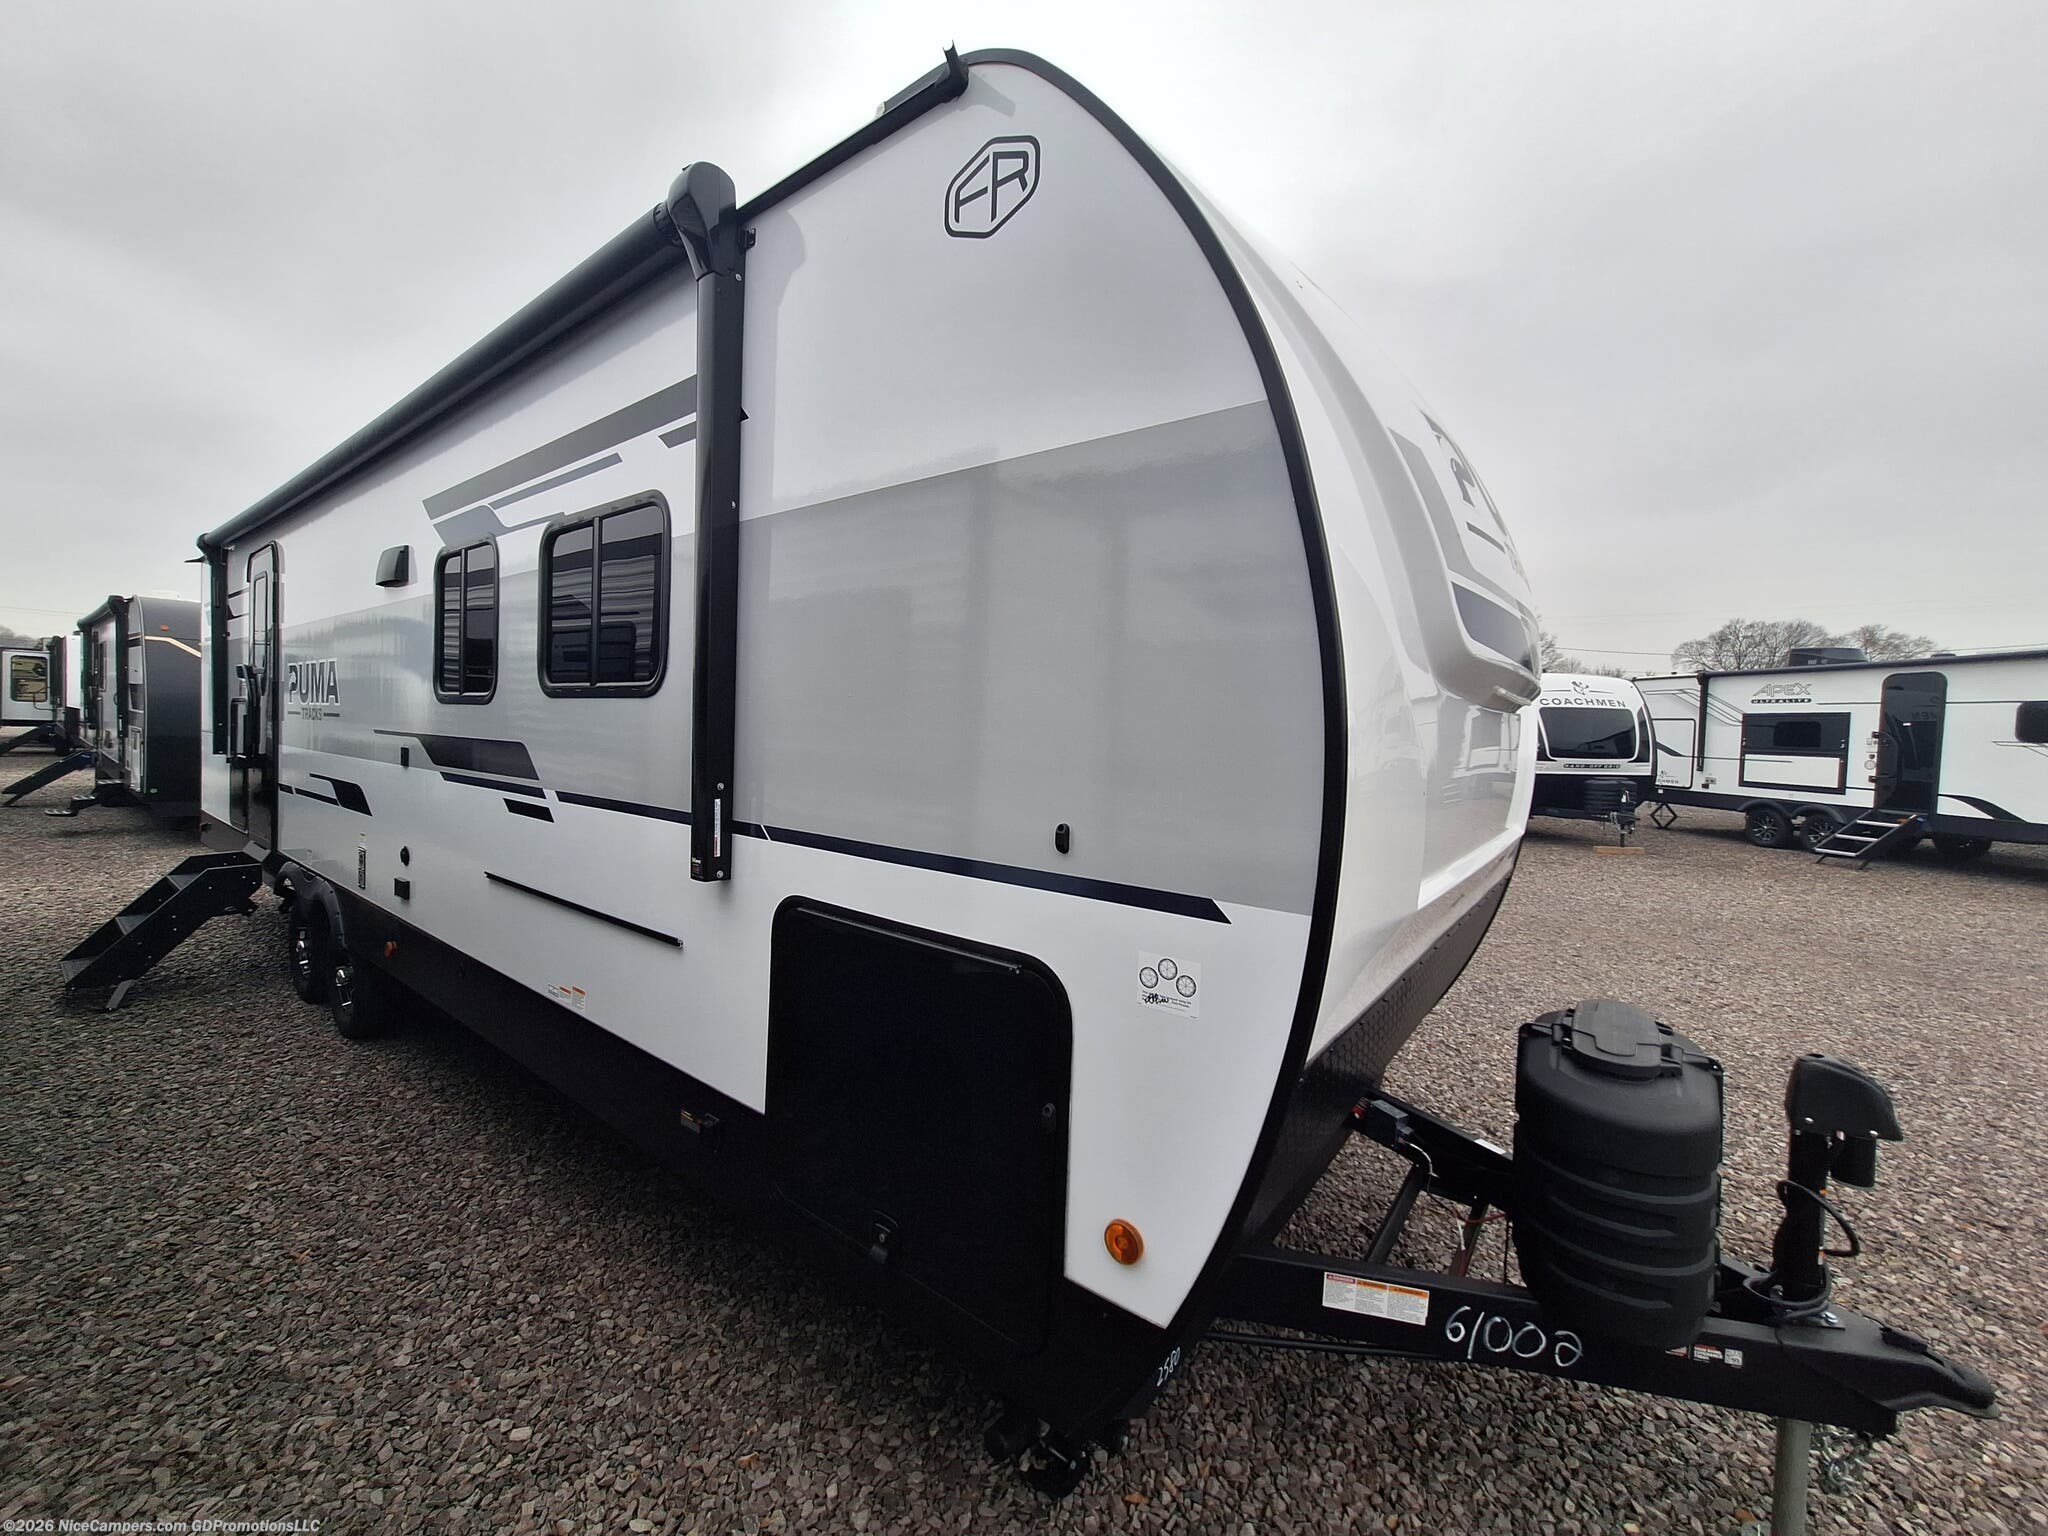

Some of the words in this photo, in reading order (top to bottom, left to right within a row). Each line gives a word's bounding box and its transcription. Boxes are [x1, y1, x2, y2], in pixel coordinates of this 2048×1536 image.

[287, 658, 340, 705] PUMA
[1752, 682, 1813, 697] APEX
[1540, 698, 1626, 707] COACHMEN
